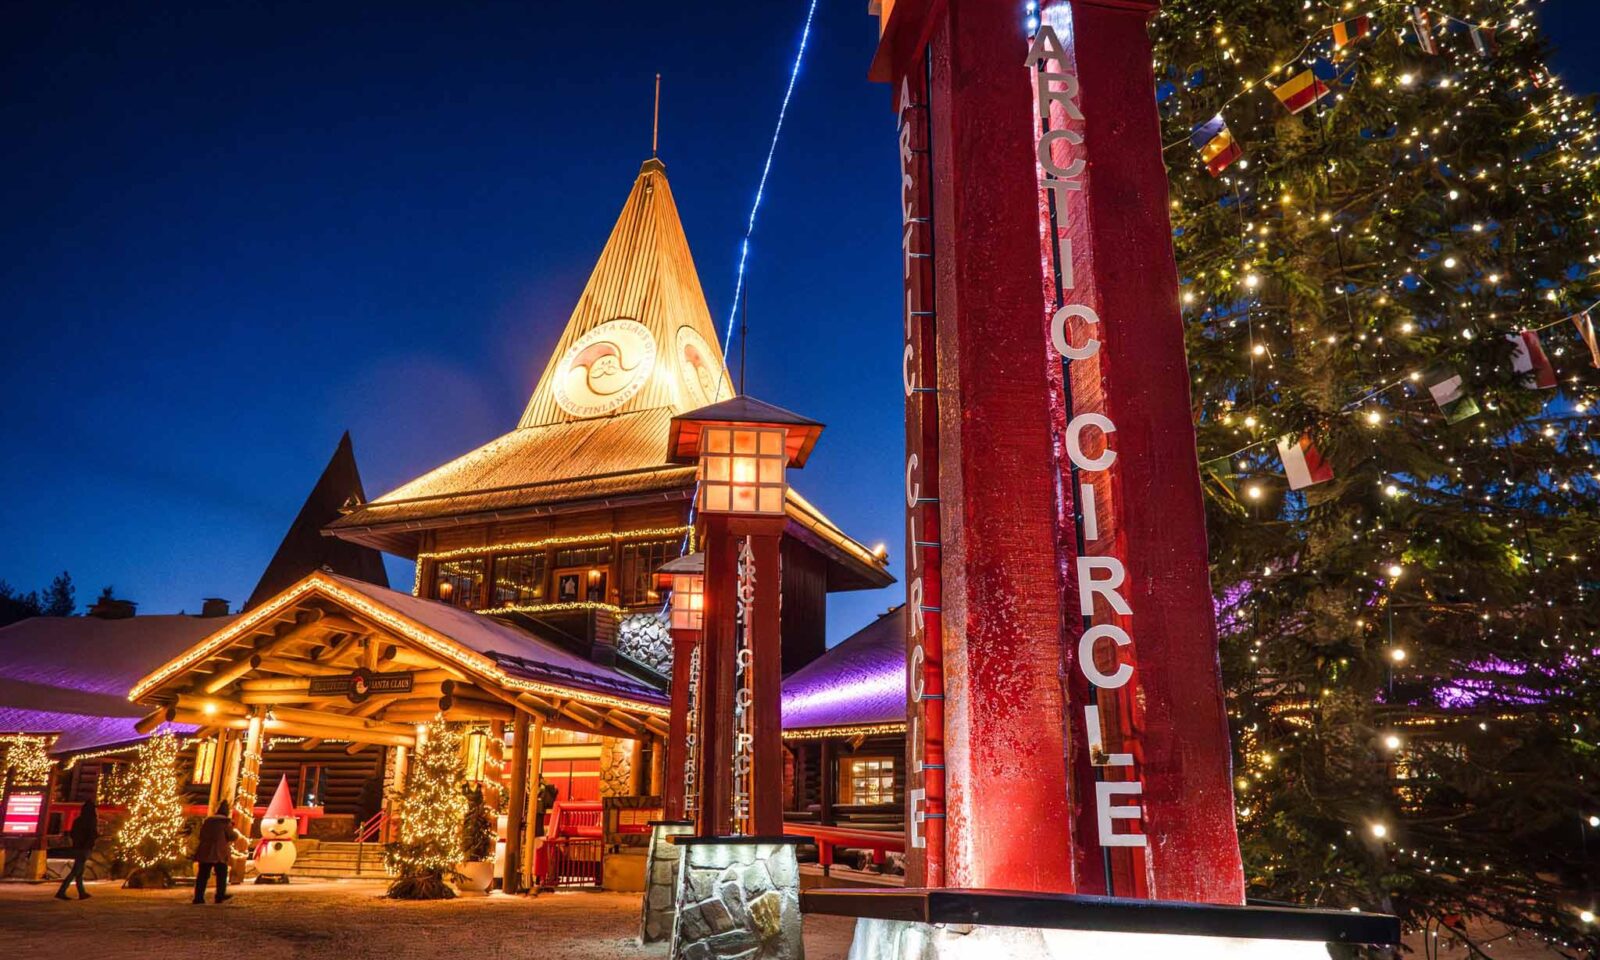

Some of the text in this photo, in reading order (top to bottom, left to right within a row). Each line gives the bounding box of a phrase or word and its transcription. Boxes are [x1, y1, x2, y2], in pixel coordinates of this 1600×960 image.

[578, 323, 617, 347] SANTA
[583, 390, 632, 415] FINLAND
[897, 75, 926, 849] ARCTIC CIRCLE
[1025, 25, 1147, 847] ARCTIC CIRCLE
[390, 679, 409, 689] CLAUS
[735, 544, 757, 819] ARCTIC CIRCLE
